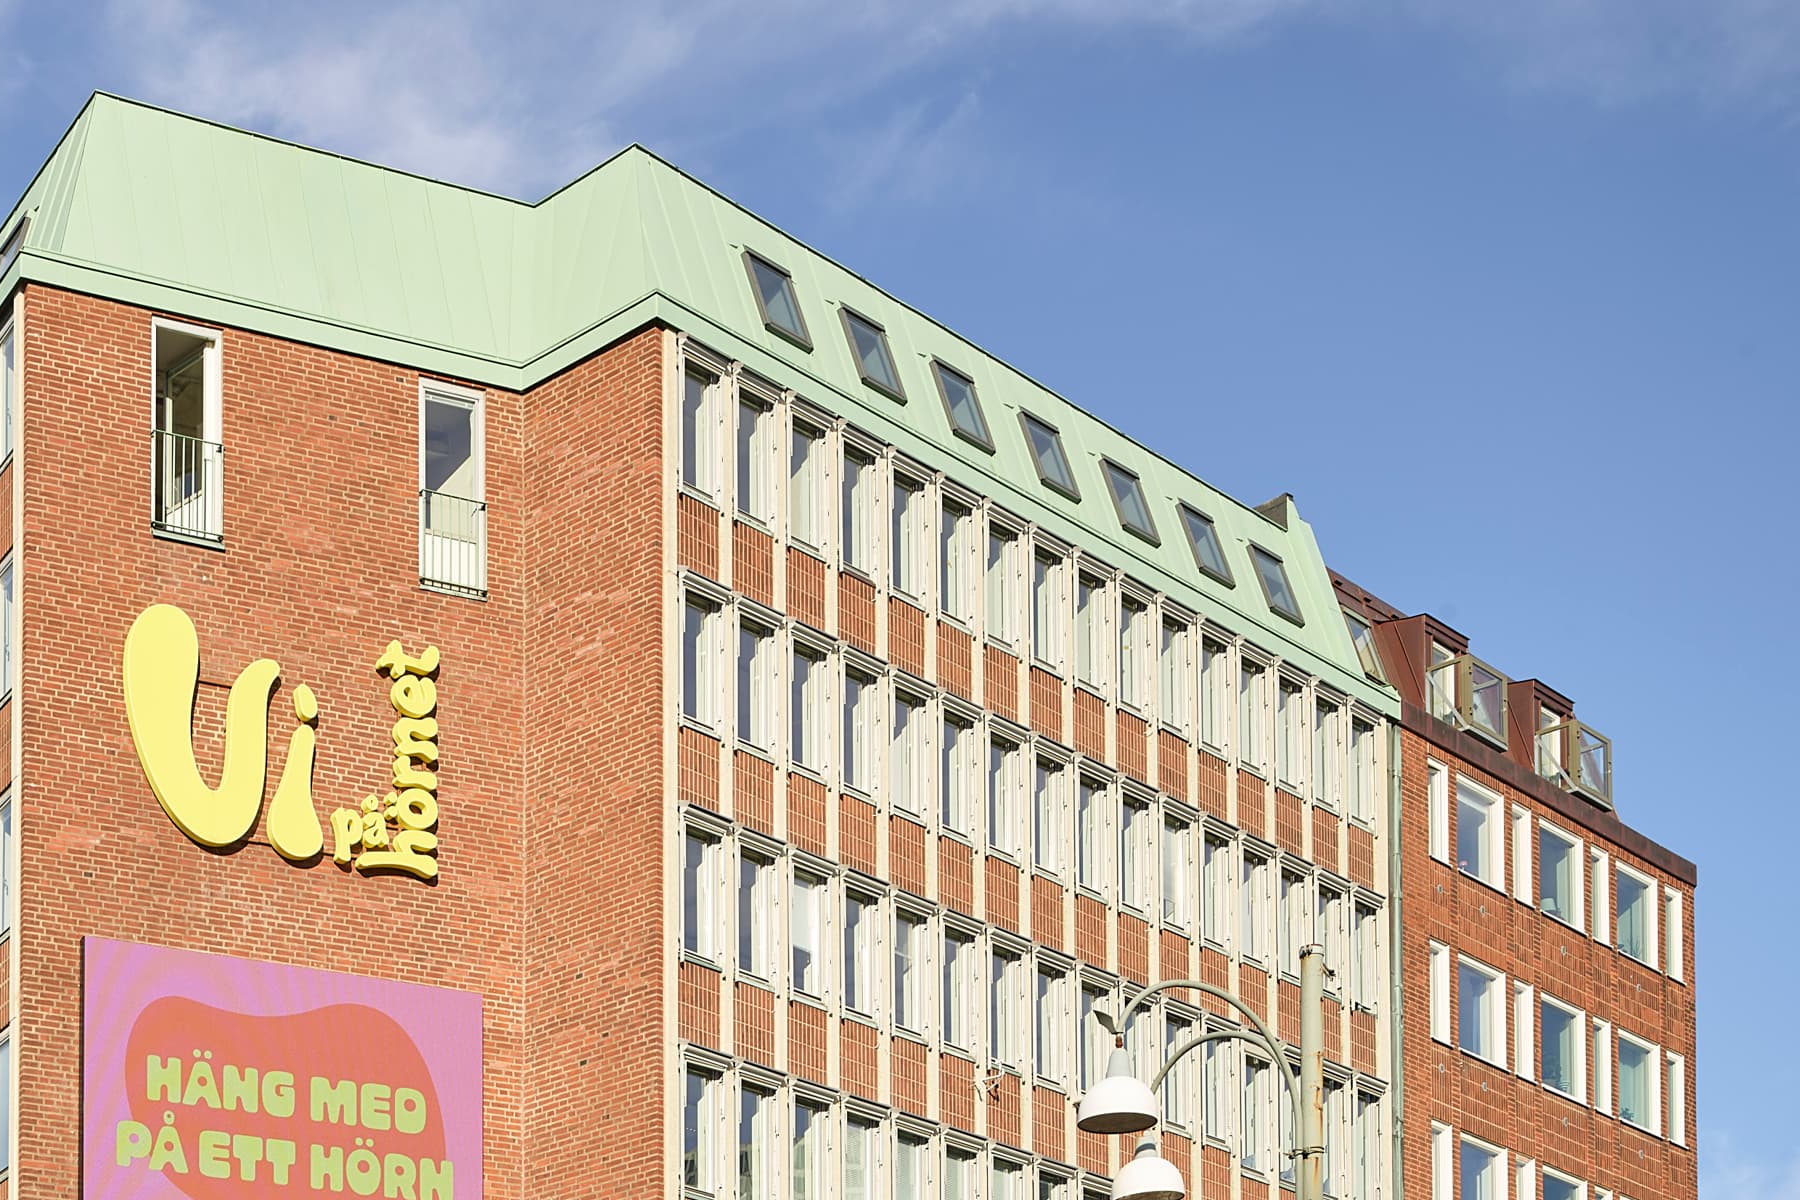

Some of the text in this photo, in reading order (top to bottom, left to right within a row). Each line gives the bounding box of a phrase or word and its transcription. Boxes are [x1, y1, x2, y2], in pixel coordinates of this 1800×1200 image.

[122, 603, 440, 879] Vi på hörnet
[146, 1049, 427, 1134] HÄNG MED
[115, 1111, 189, 1174] PÅ
[198, 1130, 296, 1185] ETT
